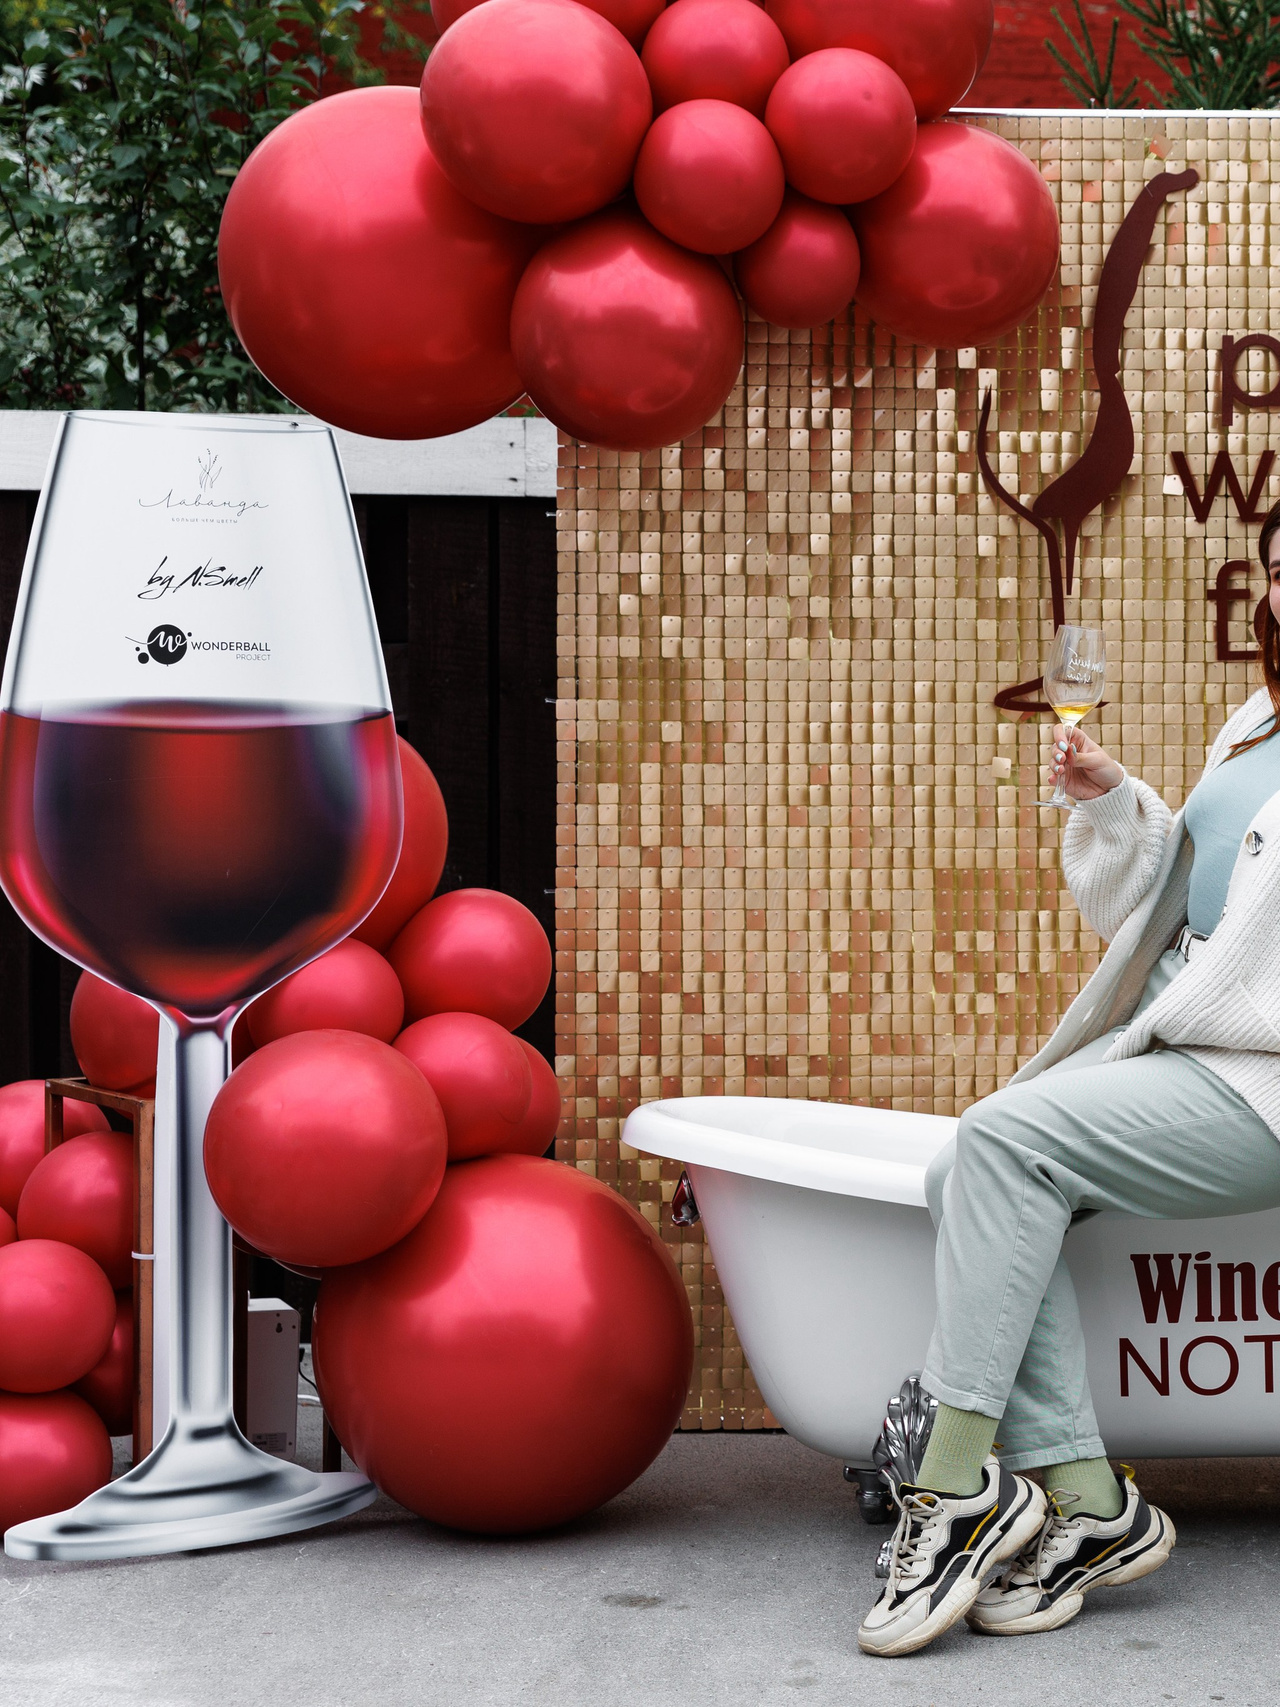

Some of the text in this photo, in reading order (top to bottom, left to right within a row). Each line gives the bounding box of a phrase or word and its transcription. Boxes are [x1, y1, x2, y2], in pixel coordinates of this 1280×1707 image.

[138, 488, 269, 517] Лаванда
[137, 555, 180, 600] by
[191, 641, 271, 652] WONDERBALL
[235, 653, 271, 661] PROJECT
